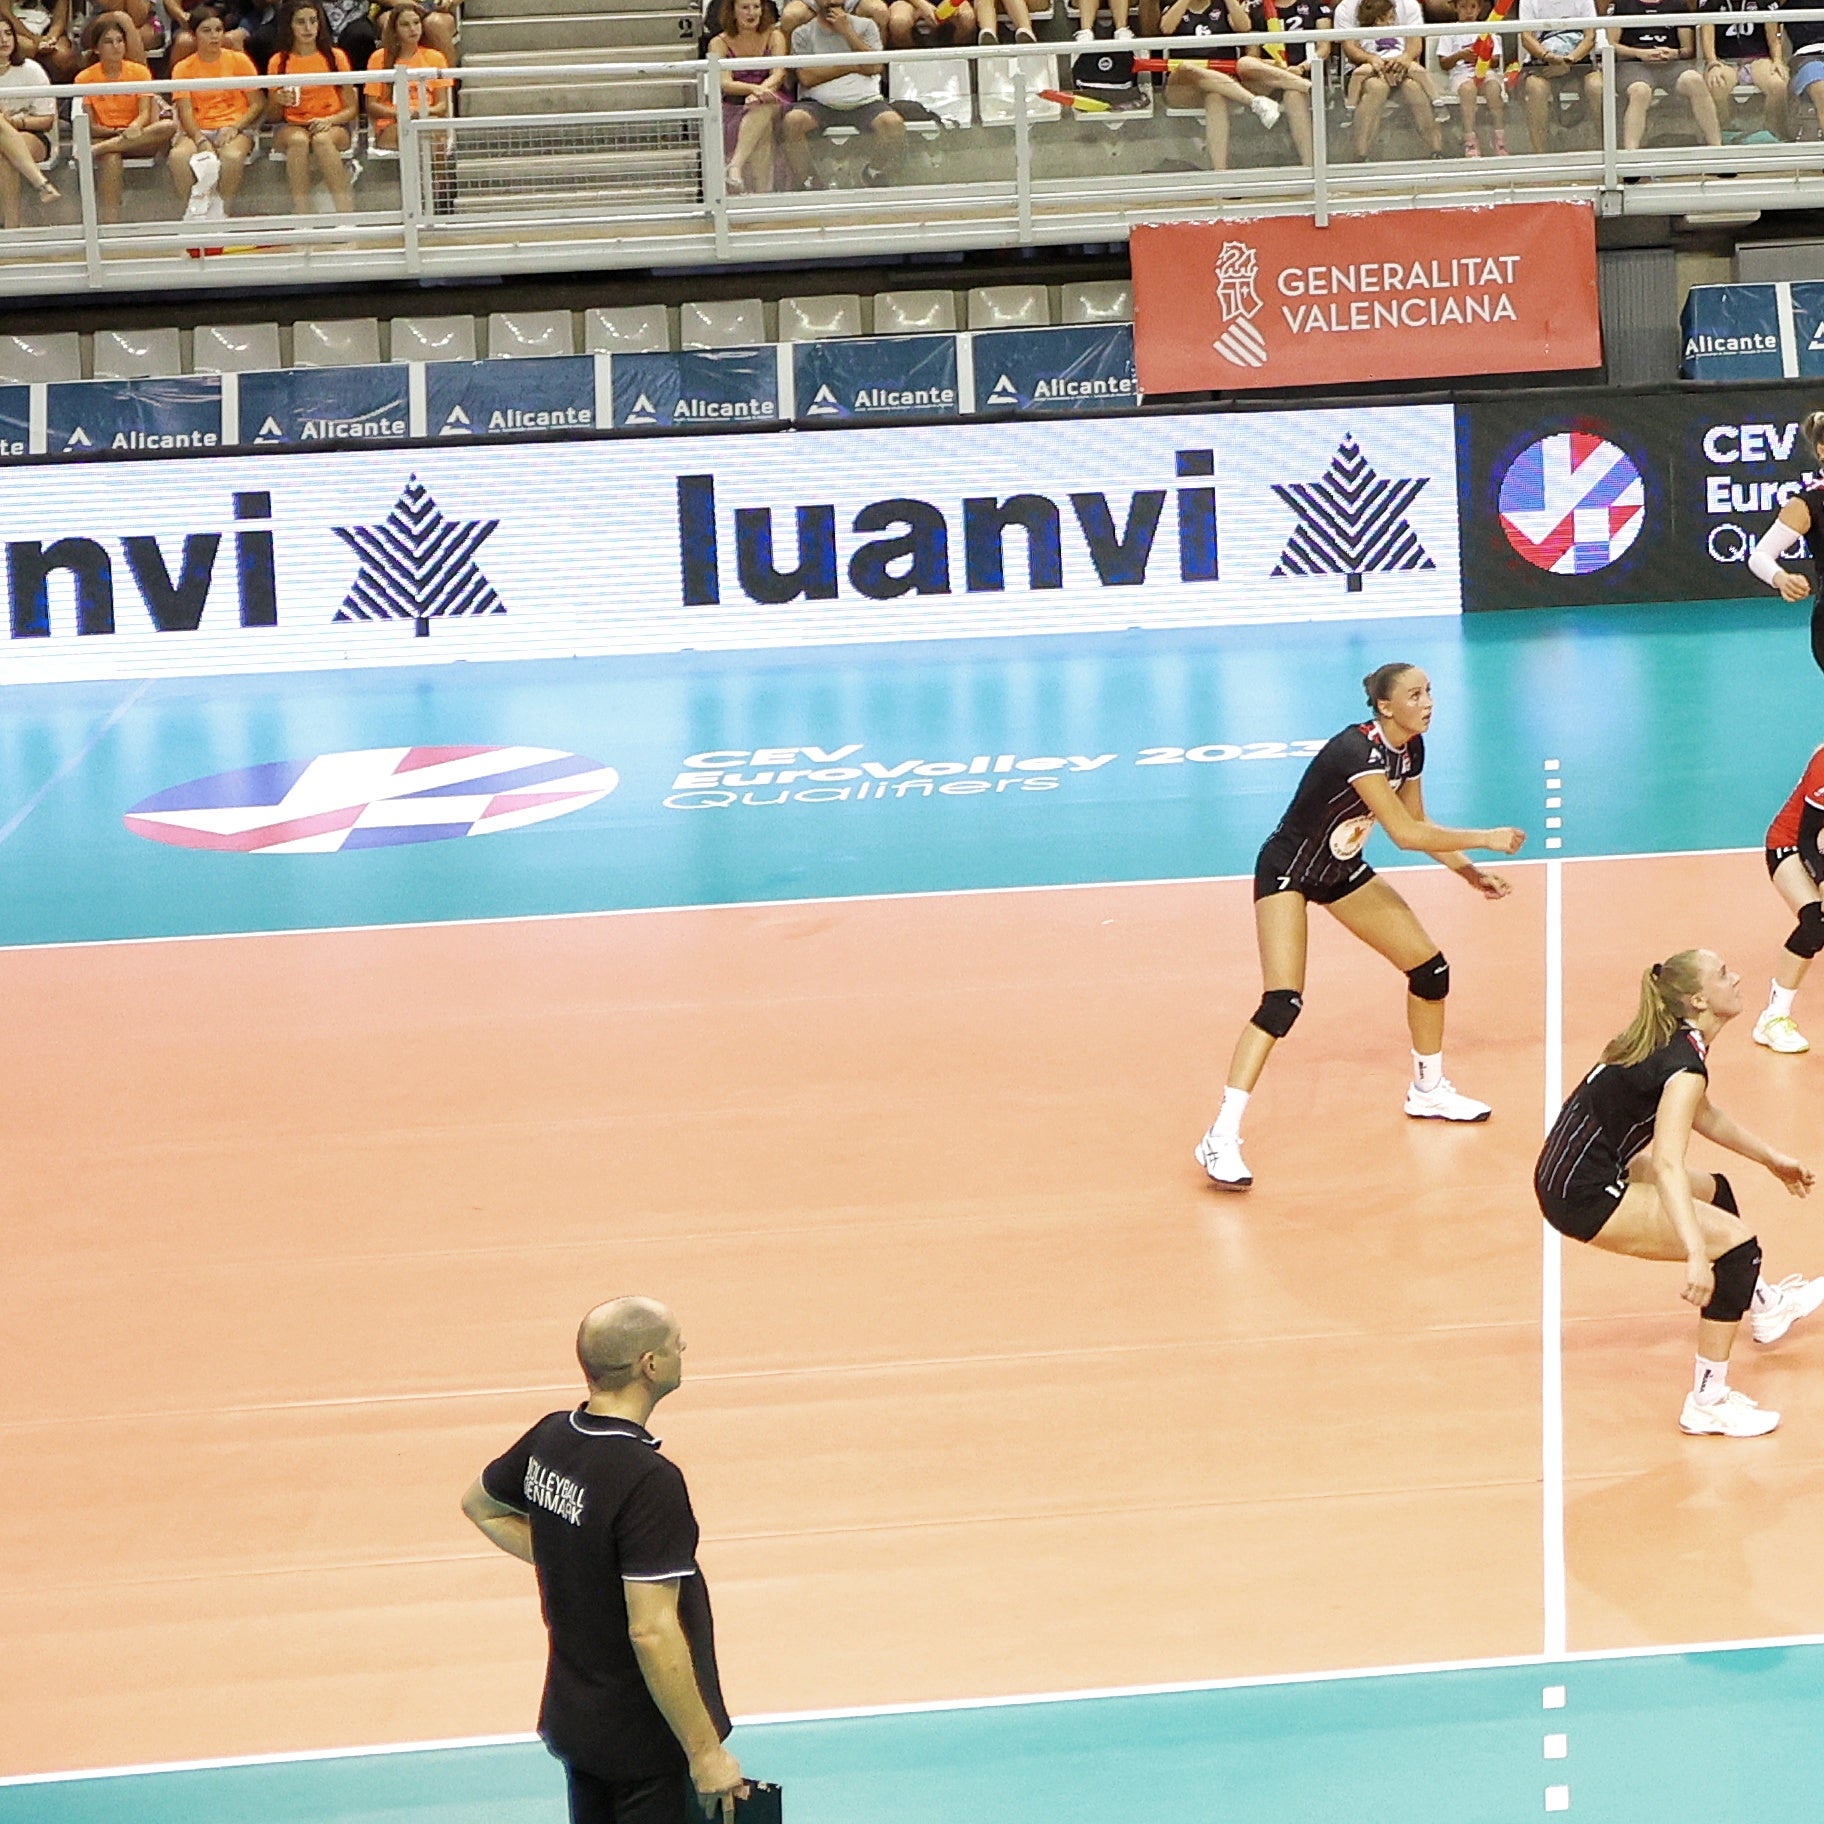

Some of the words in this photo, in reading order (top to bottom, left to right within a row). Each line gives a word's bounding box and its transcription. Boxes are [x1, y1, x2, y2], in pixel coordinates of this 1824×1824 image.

[678, 18, 693, 40] 2
[1276, 254, 1521, 298] GENERALITAT
[1280, 286, 1519, 334] VALENCIANA
[1685, 332, 1777, 354] Alicante
[854, 386, 954, 408] Alicante
[1034, 375, 1130, 397] Alicante
[489, 406, 593, 430] Alicante
[674, 397, 775, 419] Alicante
[112, 429, 218, 451] Alicante
[301, 417, 406, 442] Alicante
[1702, 422, 1800, 464] CEV
[676, 448, 1220, 607] luanvi
[671, 752, 1118, 791] EuroVolley
[1134, 739, 1329, 766] 2023
[683, 743, 864, 770] CEV
[661, 776, 1062, 810] Qualifiers
[1277, 876, 1292, 890] 7
[527, 1454, 585, 1509] VOLLEYBALL
[523, 1475, 583, 1528] DENMARK
